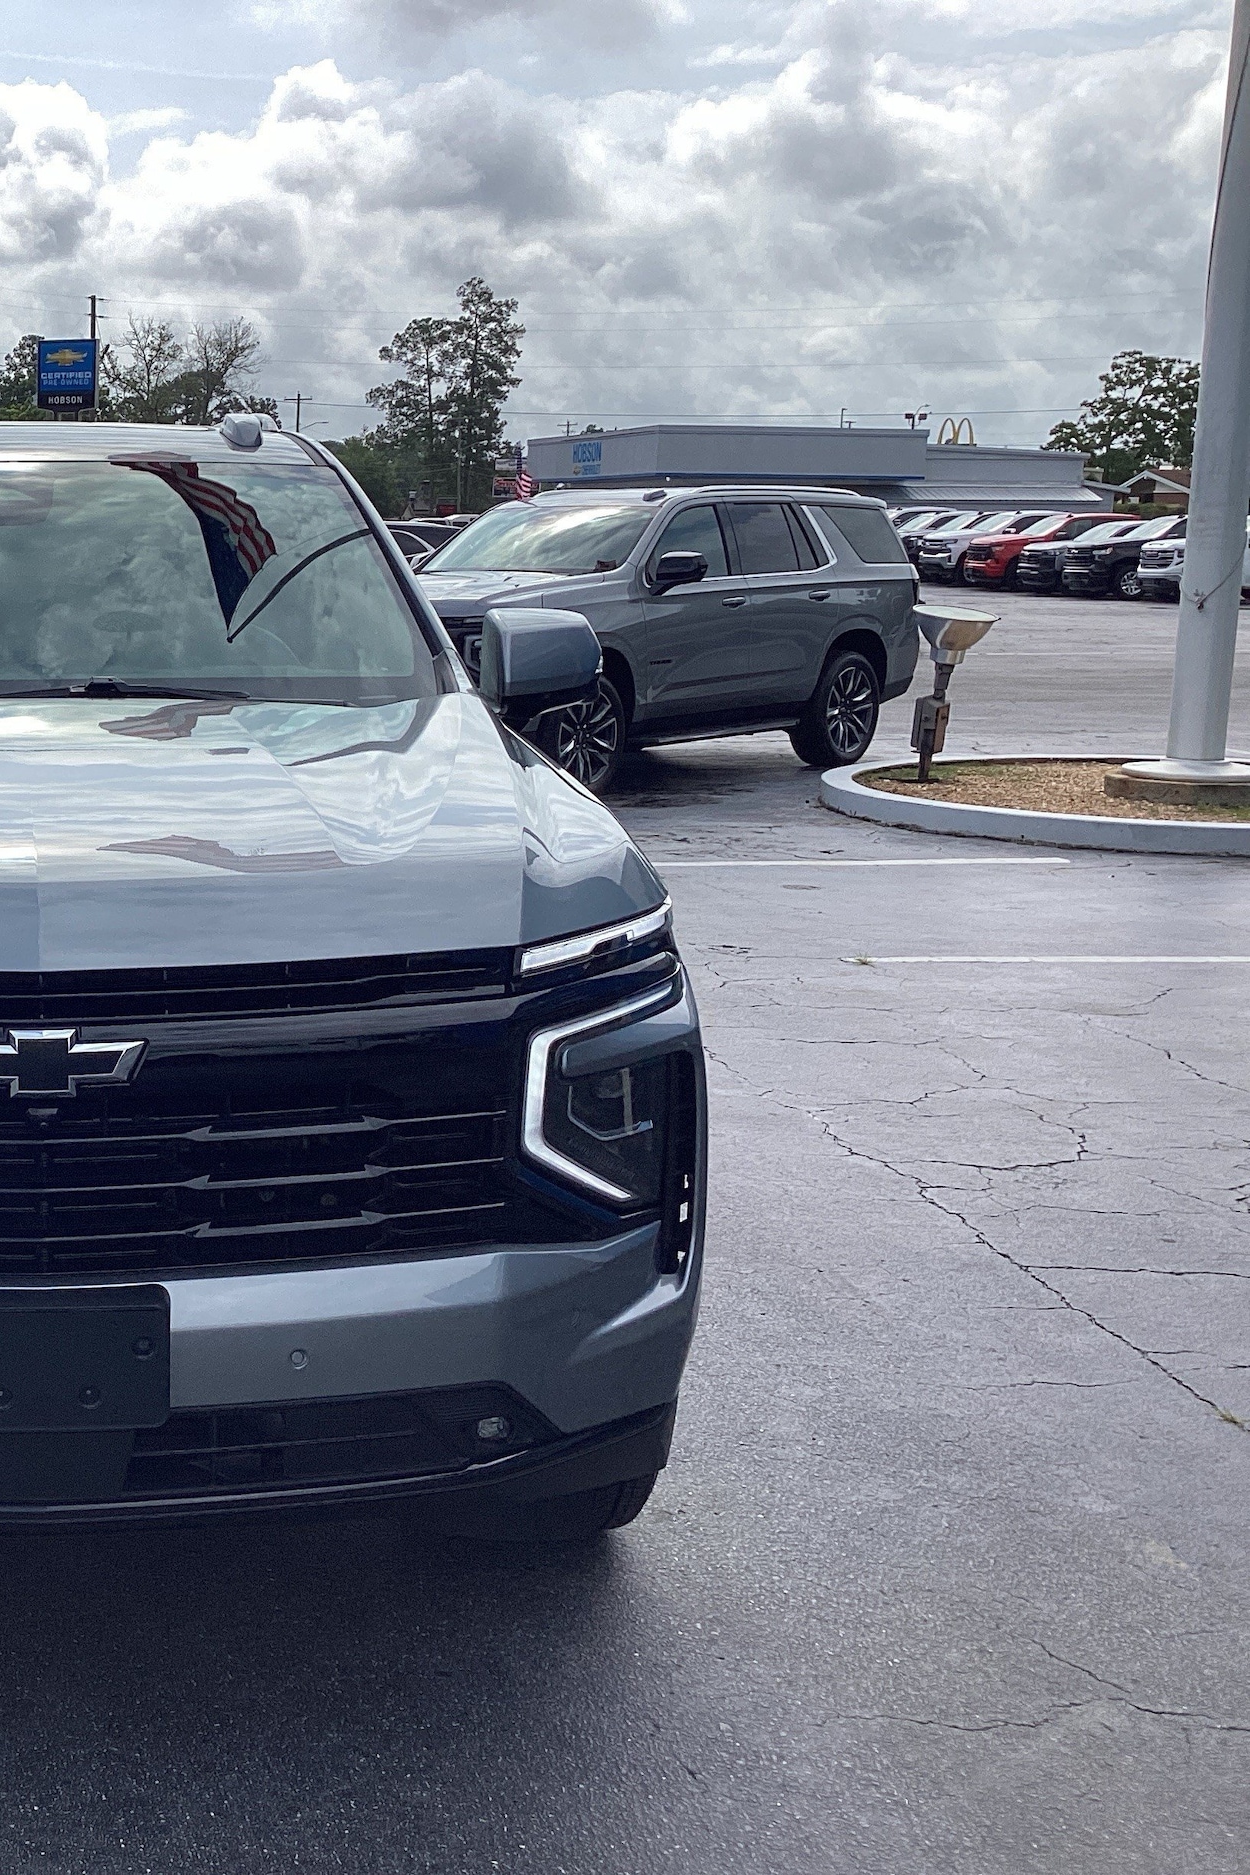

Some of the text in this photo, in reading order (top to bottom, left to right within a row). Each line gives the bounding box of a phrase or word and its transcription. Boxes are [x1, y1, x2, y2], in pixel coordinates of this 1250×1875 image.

[41, 371, 91, 379] CERTIFIED
[48, 395, 83, 405] HOBSON
[572, 441, 602, 463] HOBSON
